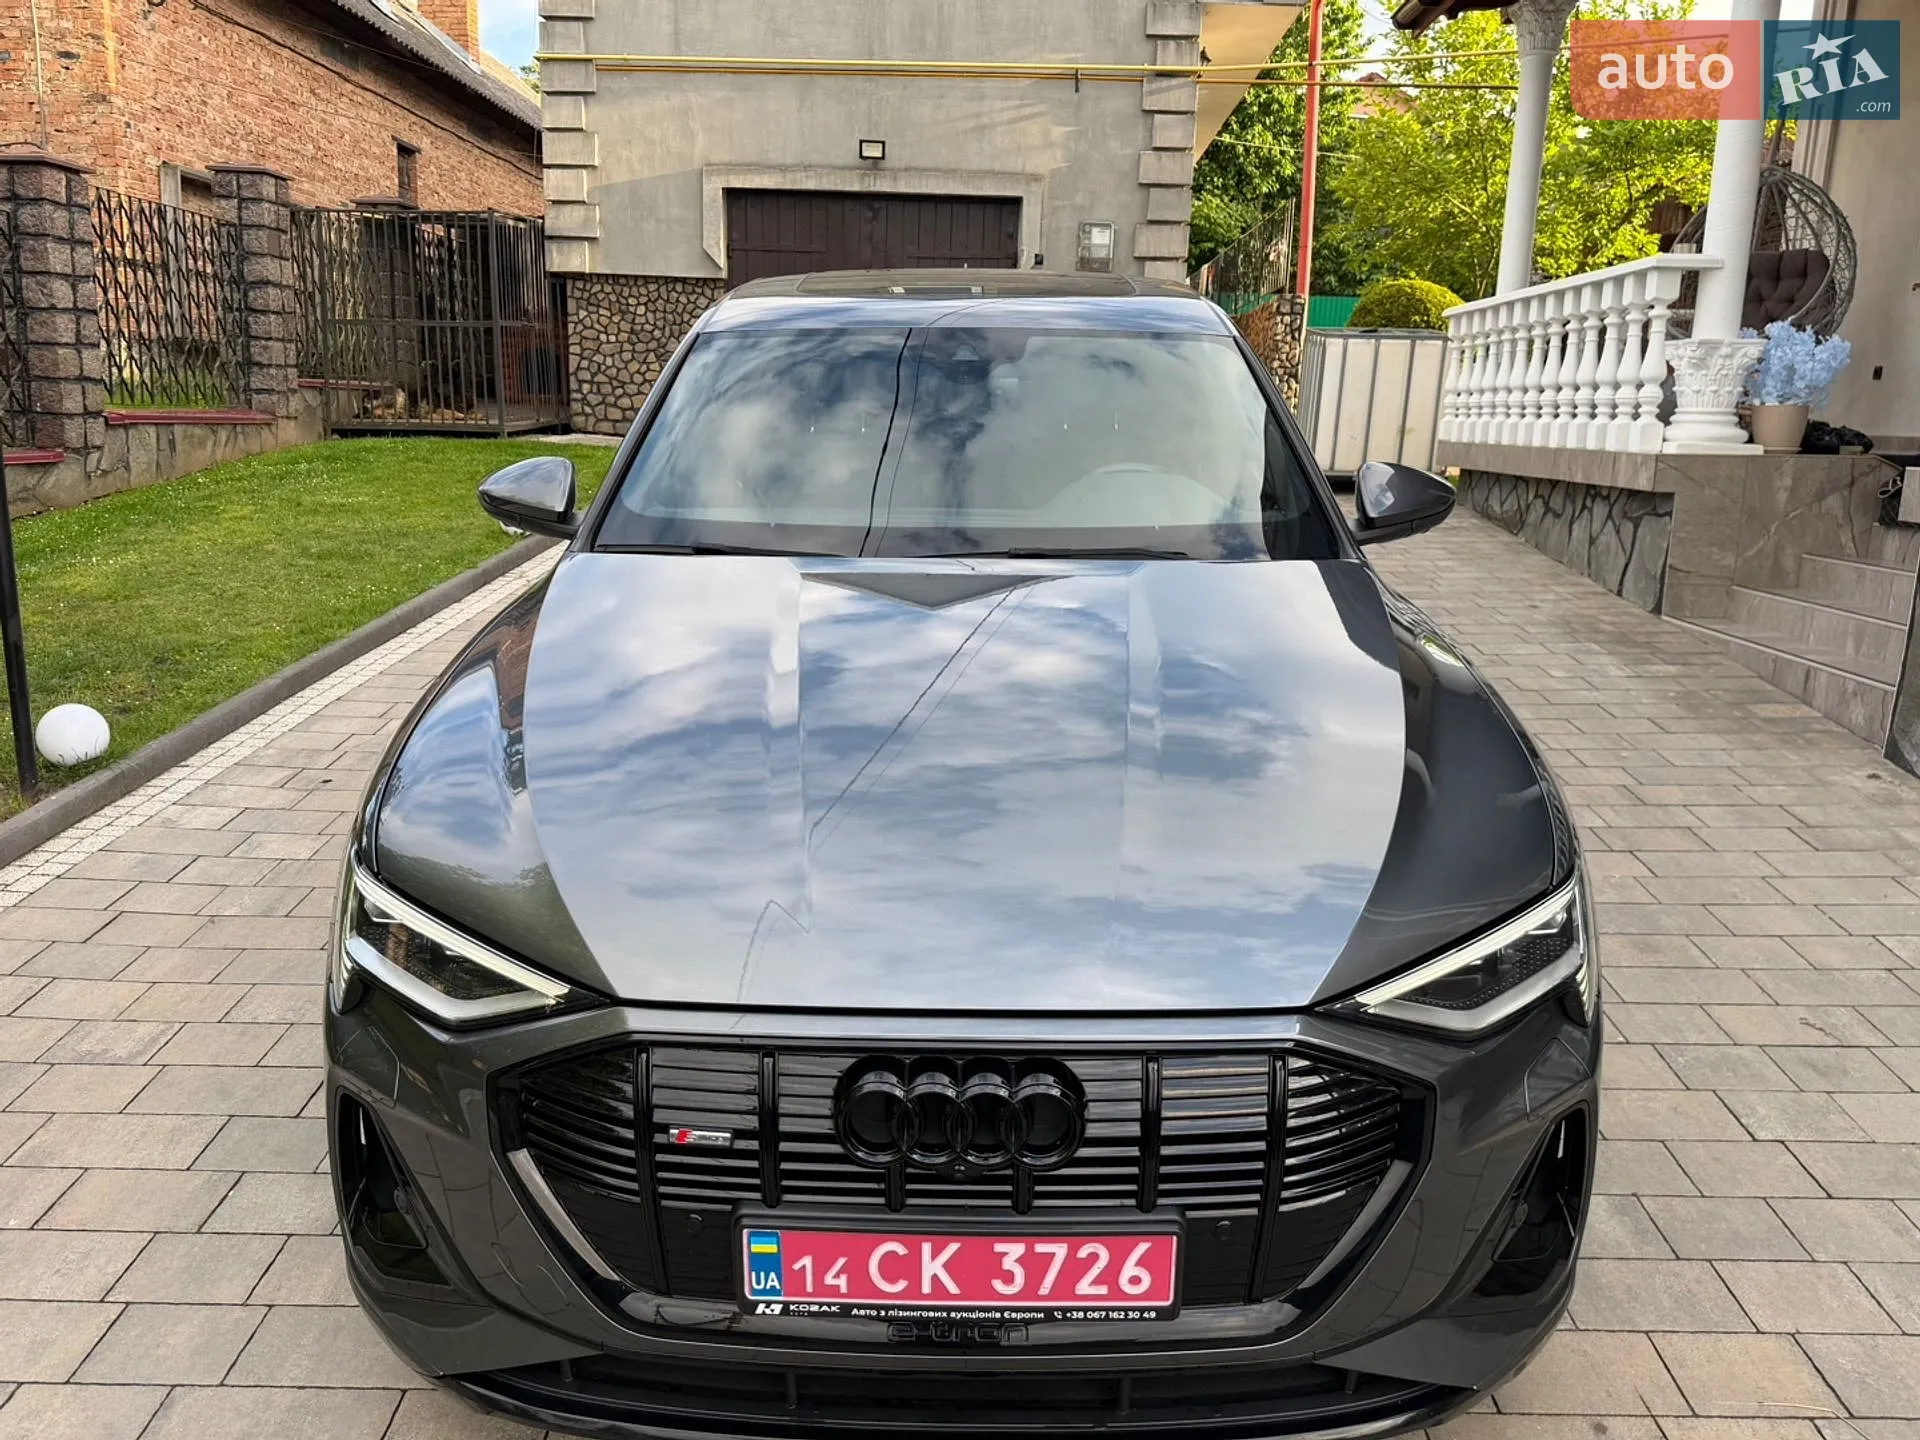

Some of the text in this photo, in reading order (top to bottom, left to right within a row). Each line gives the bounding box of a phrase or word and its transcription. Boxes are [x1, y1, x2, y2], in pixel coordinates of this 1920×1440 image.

[791, 1240, 1153, 1296] 14 CK 3726
[751, 1271, 781, 1290] UA
[851, 1308, 877, 1316] Авто
[887, 1308, 948, 1319] лізингових
[950, 1309, 1001, 1320] аукціонів
[1003, 1310, 1045, 1320] Європи
[1066, 1311, 1157, 1319] +38 067 162 30 49
